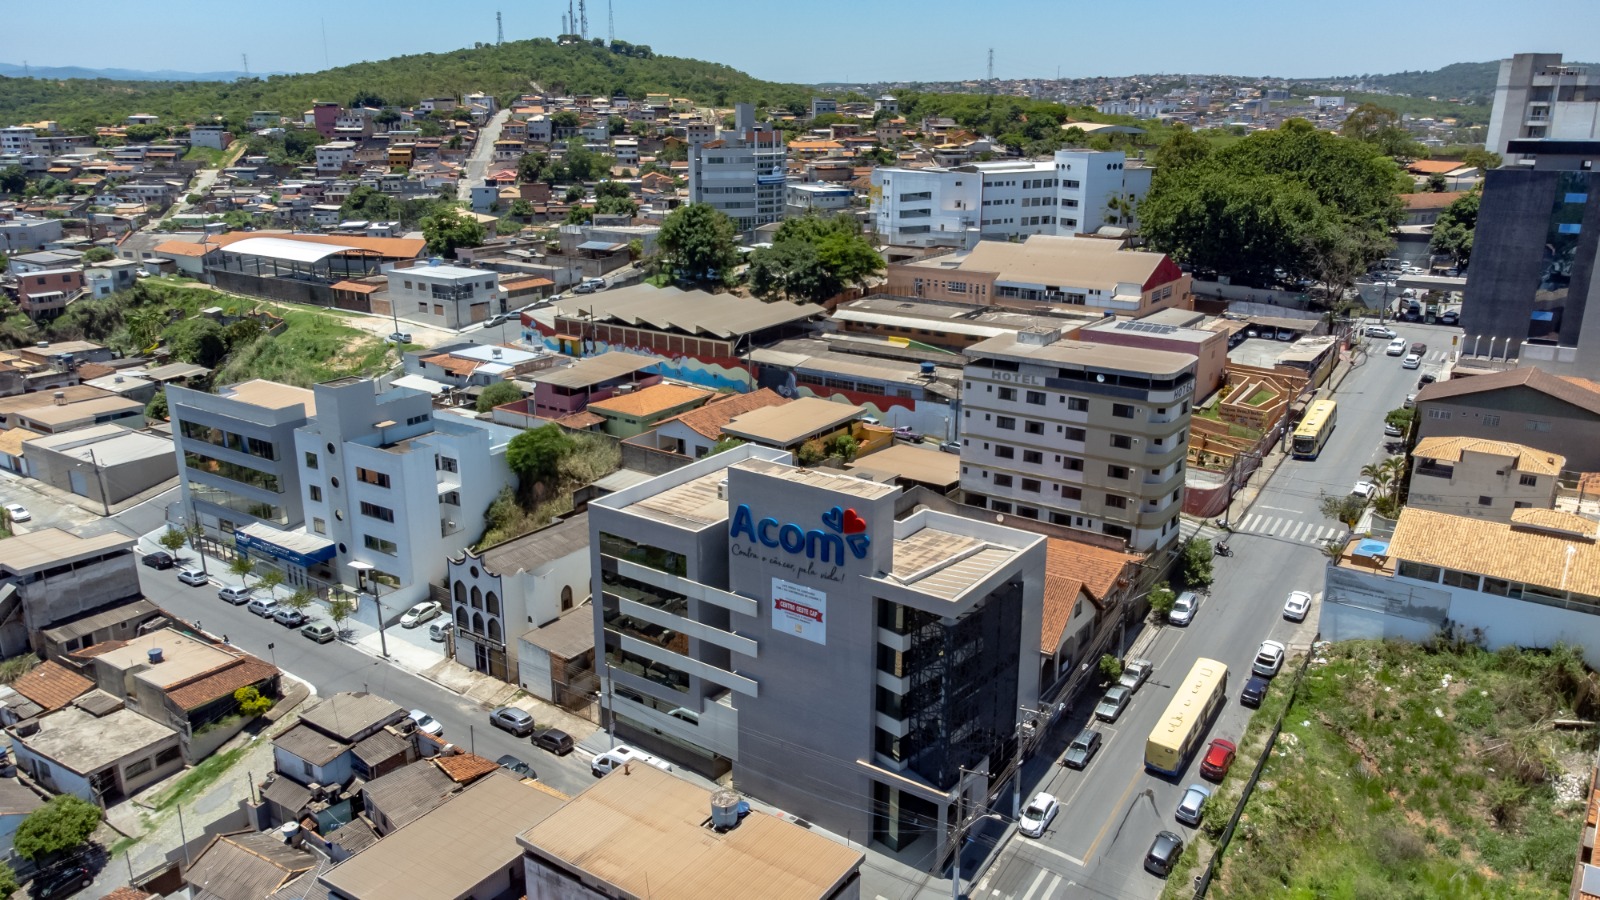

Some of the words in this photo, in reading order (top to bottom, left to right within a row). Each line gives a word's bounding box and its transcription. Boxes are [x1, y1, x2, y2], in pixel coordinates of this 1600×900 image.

[991, 370, 1040, 385] HOTEL
[1173, 382, 1193, 400] HOTEL
[730, 504, 845, 567] Acom
[731, 543, 759, 559] Contra
[796, 561, 817, 579] pela
[820, 566, 845, 583] vida!
[780, 601, 795, 611] CENTRO
[796, 604, 809, 615] OESTE
[809, 609, 818, 618] CAP
